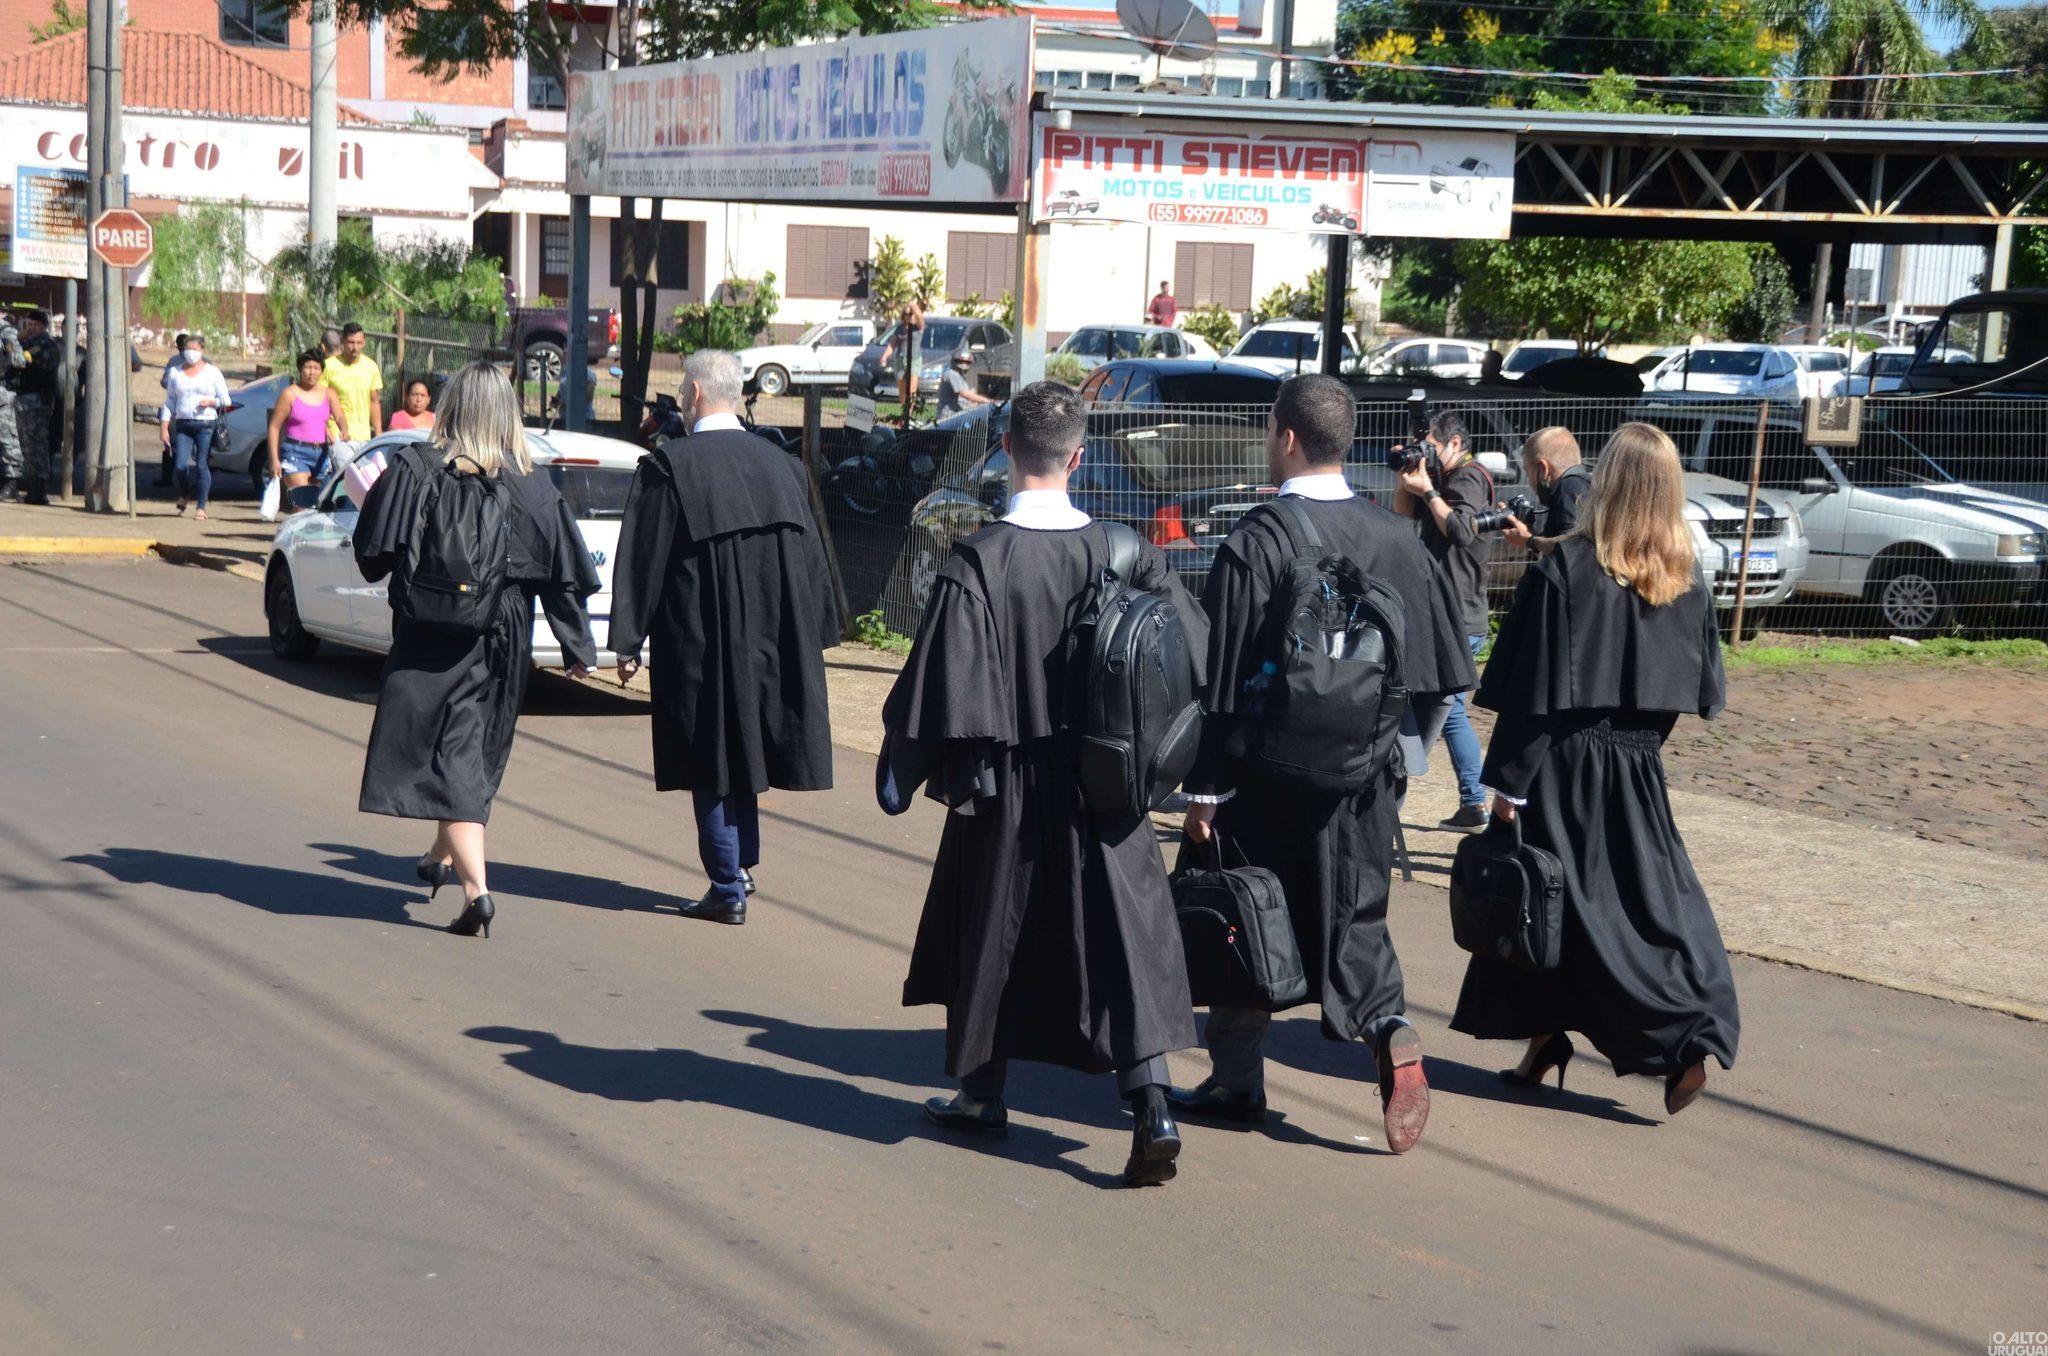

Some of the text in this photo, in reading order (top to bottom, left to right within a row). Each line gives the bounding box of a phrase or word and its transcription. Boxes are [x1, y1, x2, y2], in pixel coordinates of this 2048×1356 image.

[735, 63, 800, 143] MOTOS
[1054, 134, 1358, 182] PITTI STIEVEN
[1103, 178, 1183, 198] MOTOS
[1203, 179, 1312, 204] VEÍCULOS
[1150, 204, 1263, 225] (55) 99977-1086
[98, 228, 147, 248] PARE
